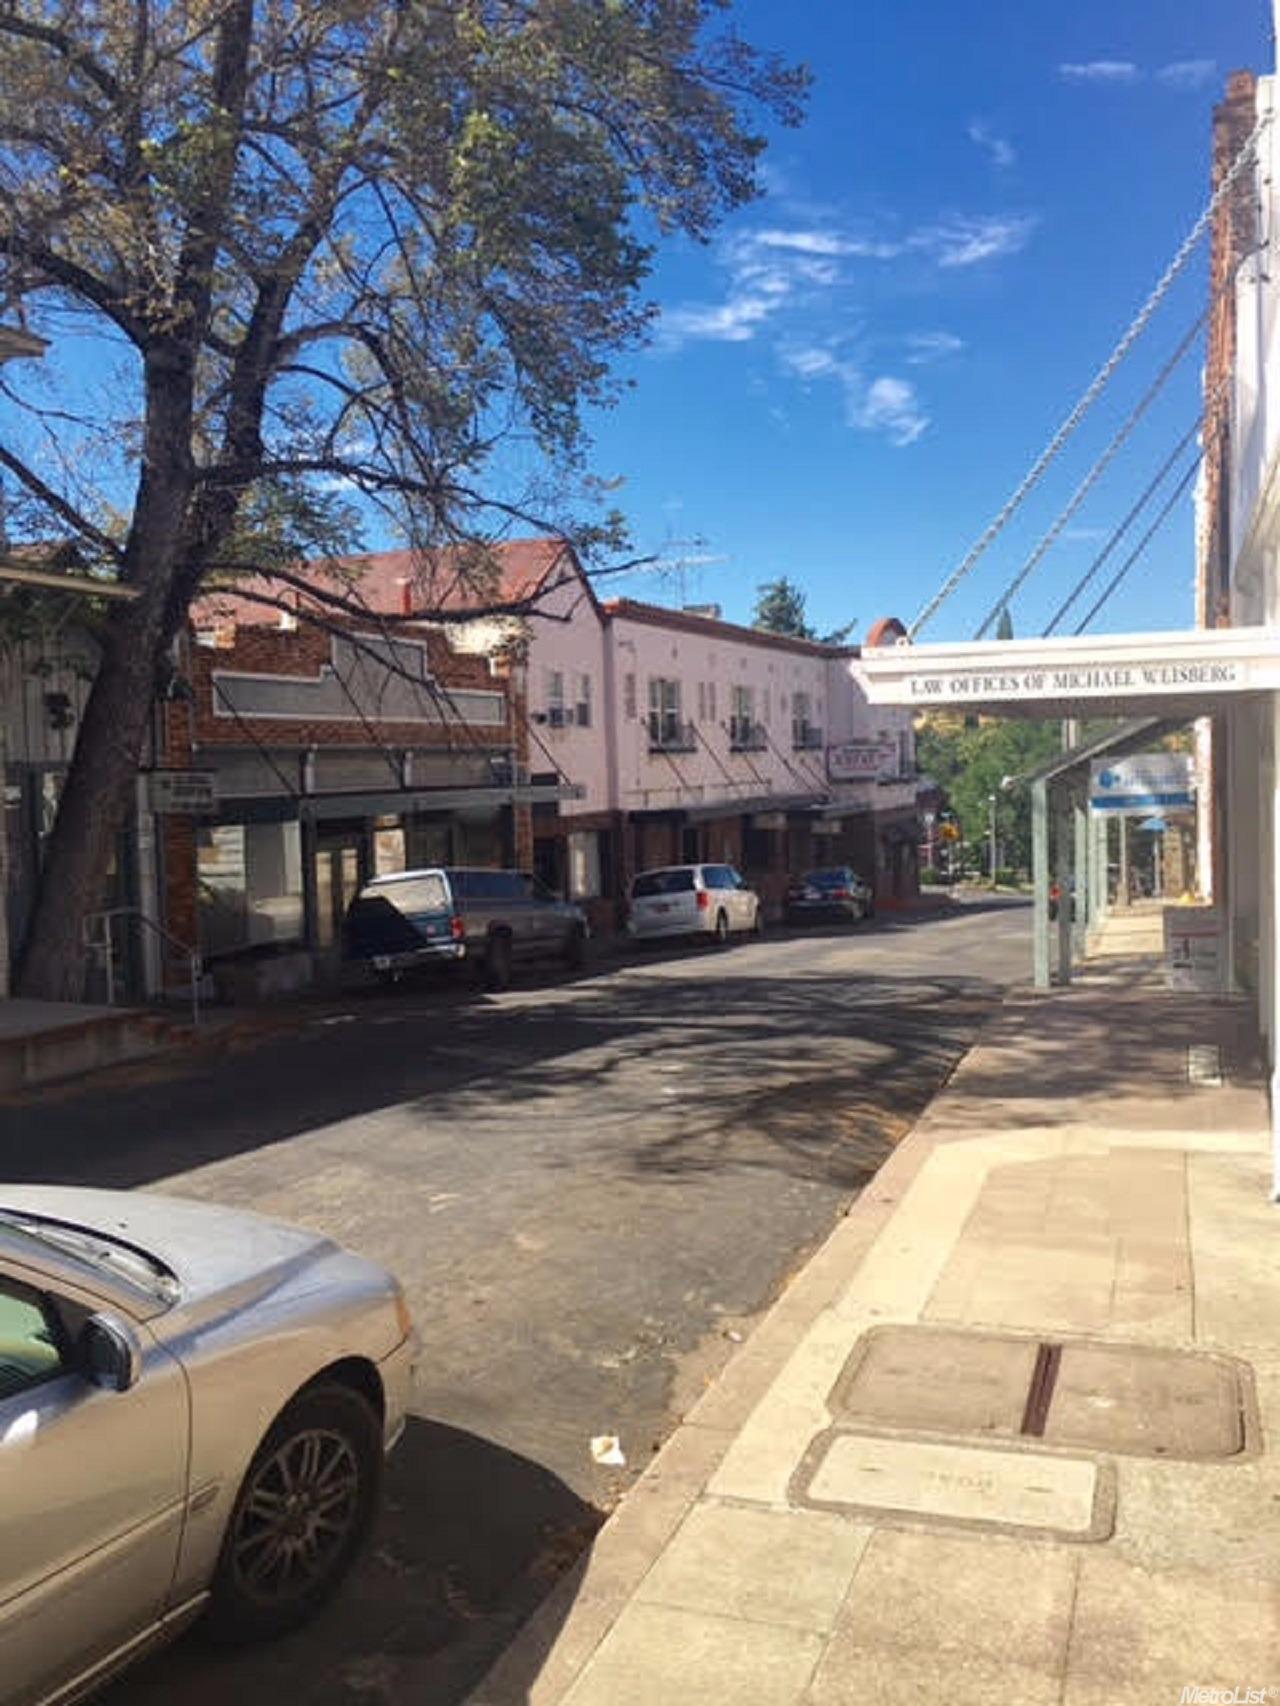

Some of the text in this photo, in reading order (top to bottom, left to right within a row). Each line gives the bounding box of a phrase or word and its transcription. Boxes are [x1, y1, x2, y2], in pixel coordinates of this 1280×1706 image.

[911, 678, 943, 695] LAW
[949, 675, 1020, 695] OFFICES
[1023, 673, 1045, 691] OF
[1053, 670, 1135, 690] MICHAEL
